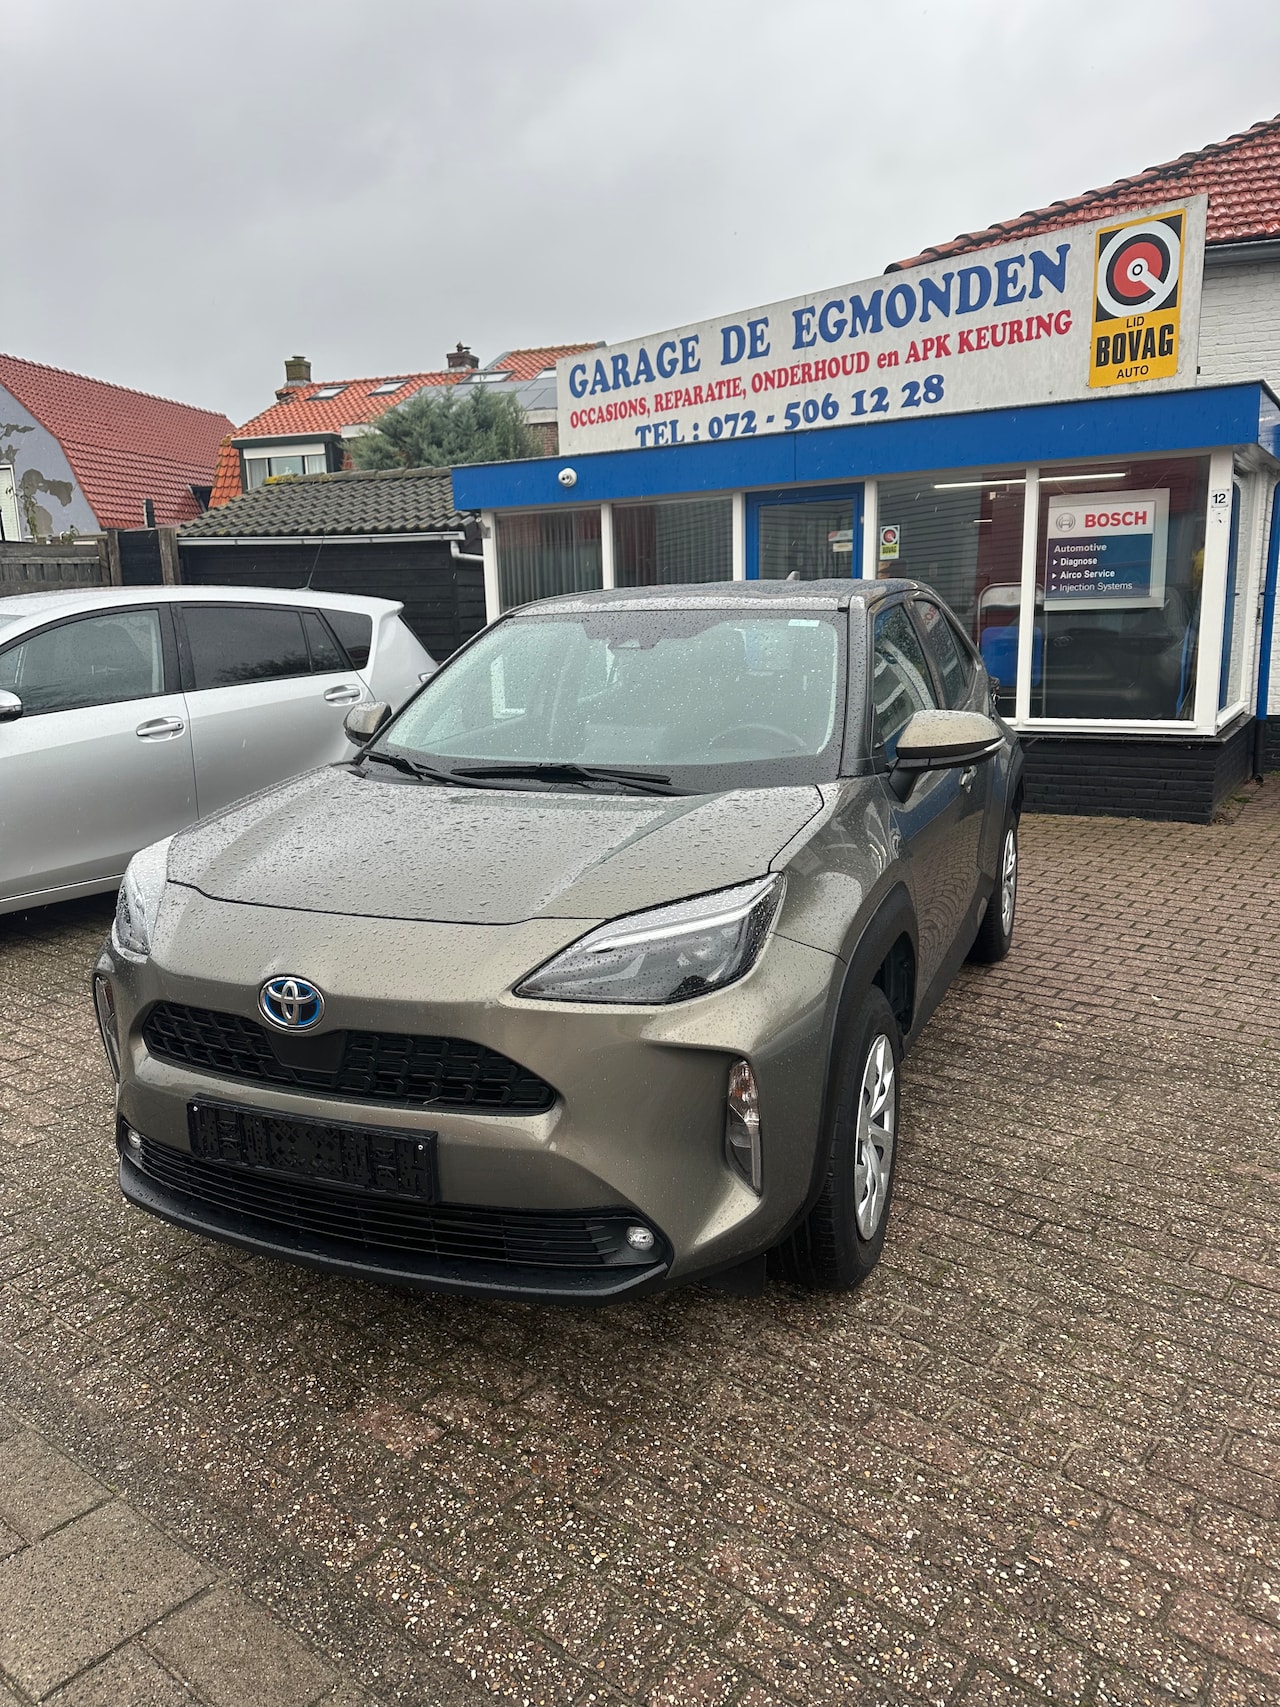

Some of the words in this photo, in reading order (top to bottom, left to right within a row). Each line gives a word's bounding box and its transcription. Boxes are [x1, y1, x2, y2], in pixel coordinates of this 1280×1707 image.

[569, 334, 700, 398] GARAGE
[720, 317, 770, 365] DE
[792, 244, 1070, 349] EGMONDEN
[1126, 316, 1145, 329] LID
[1095, 323, 1175, 368] BOVAG
[570, 395, 650, 429] OCCASIONS,
[654, 376, 746, 412] REPARATIE,
[751, 351, 869, 393] ONDERHOUD
[877, 350, 899, 369] en
[905, 333, 951, 364] APK
[957, 309, 1073, 355] KEURING
[1116, 365, 1149, 379] AUTO
[708, 410, 756, 439] 072
[784, 392, 839, 430] 506
[850, 387, 889, 416] 12
[901, 373, 944, 409] 28
[1212, 493, 1226, 504] 12
[1084, 511, 1148, 528] BOSCH
[1054, 543, 1107, 553] Automotive
[1060, 557, 1098, 567] Diagnose
[1060, 571, 1082, 579] Airco
[1084, 569, 1115, 578] Service
[1060, 583, 1095, 593] Injection
[1097, 581, 1133, 592] Systems
